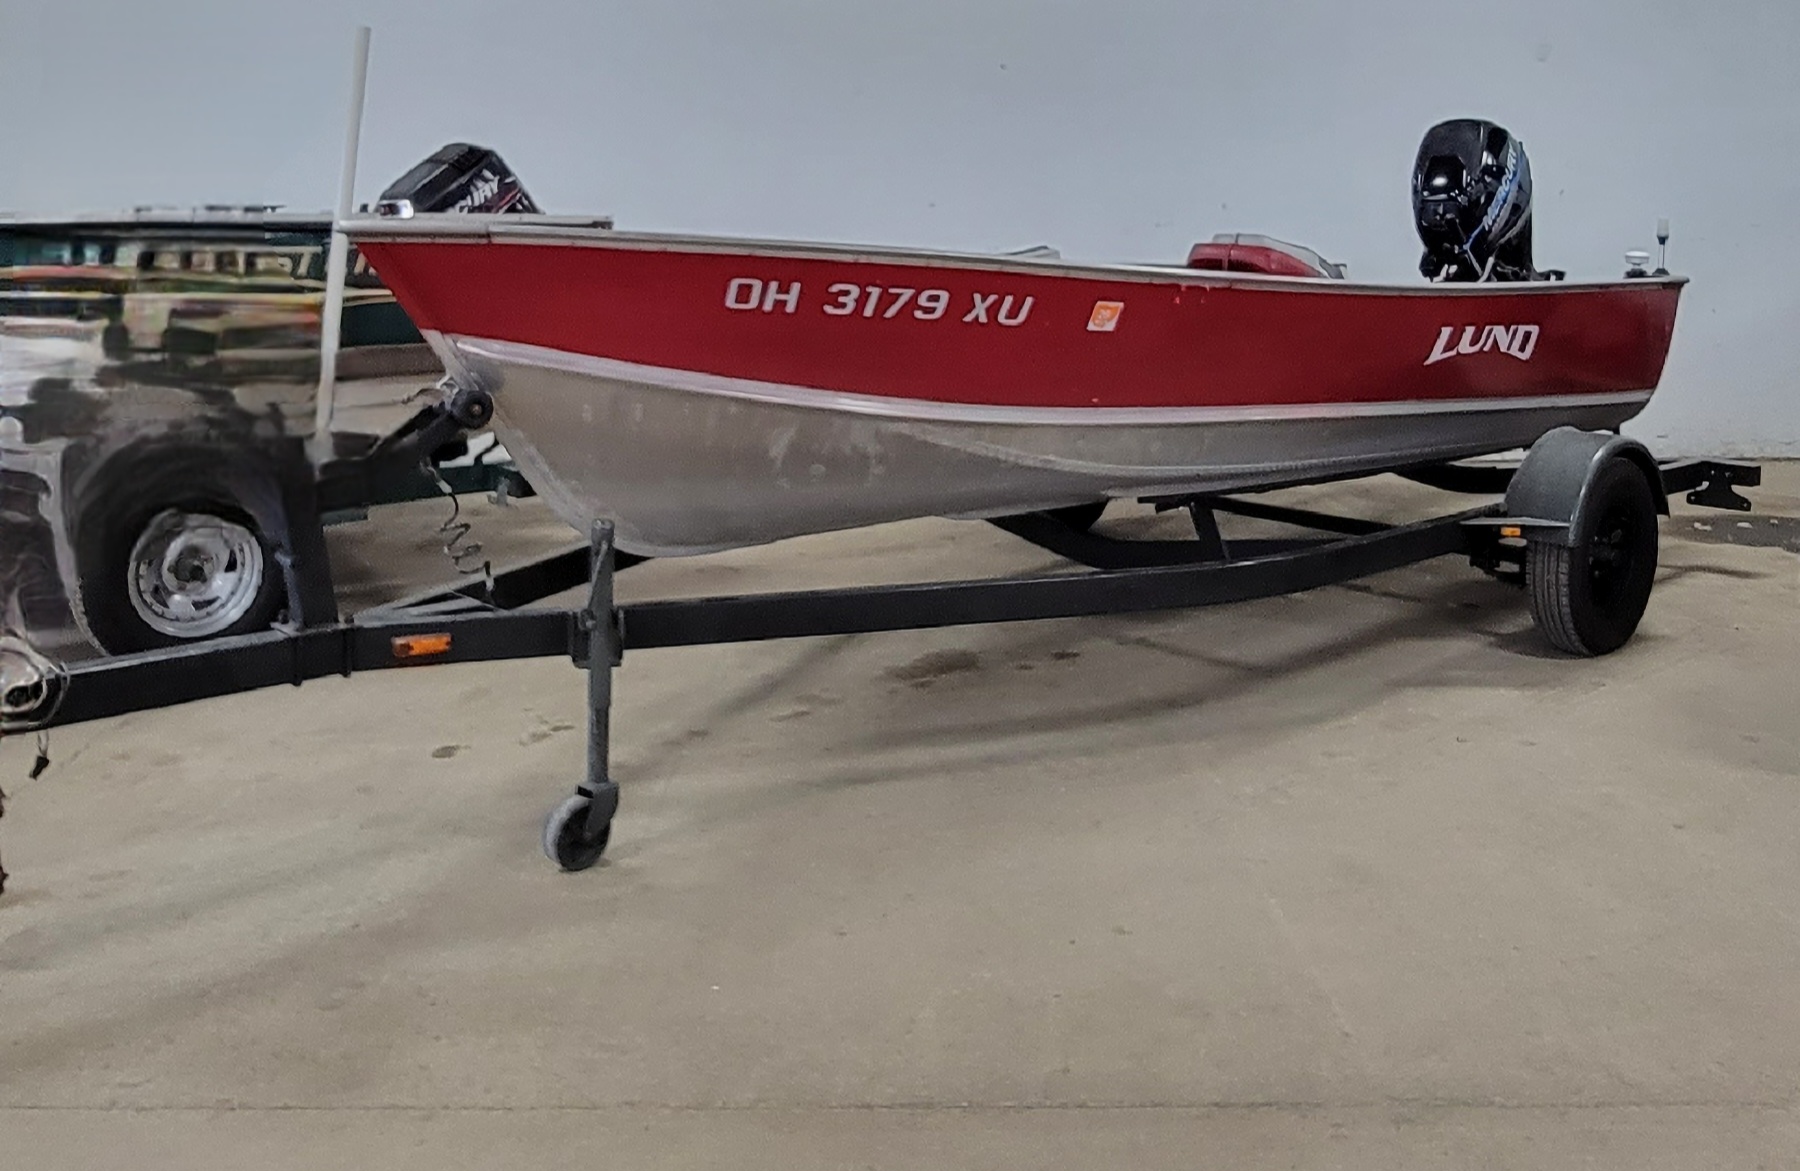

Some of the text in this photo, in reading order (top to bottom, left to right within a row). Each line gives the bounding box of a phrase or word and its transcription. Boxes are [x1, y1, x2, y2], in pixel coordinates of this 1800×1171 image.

[725, 278, 1034, 327] OH 3179 XU
[1423, 325, 1540, 366] LUND
